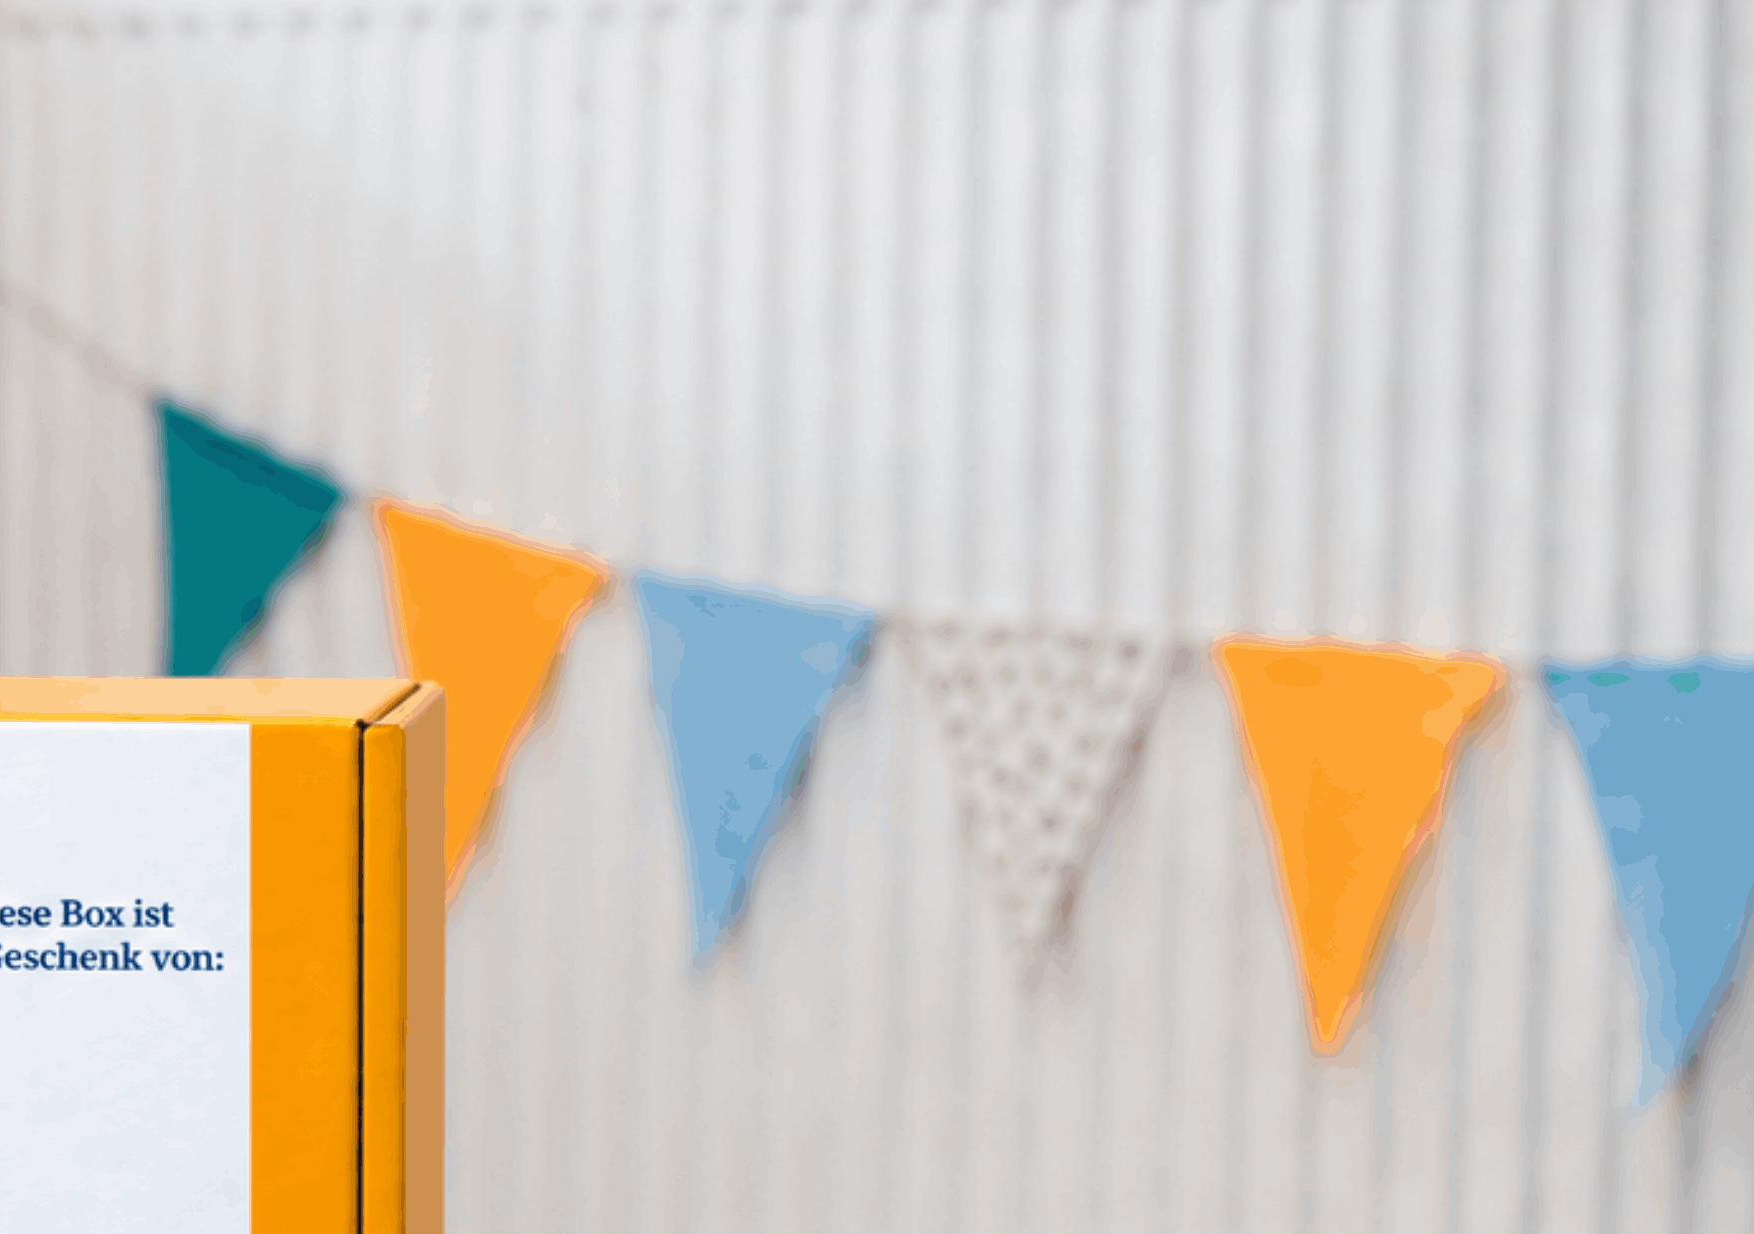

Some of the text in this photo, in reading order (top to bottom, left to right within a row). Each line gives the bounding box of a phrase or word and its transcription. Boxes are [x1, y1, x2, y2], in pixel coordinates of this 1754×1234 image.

[60, 898, 125, 928] Box
[133, 898, 174, 928] ist
[150, 949, 224, 972] von:
